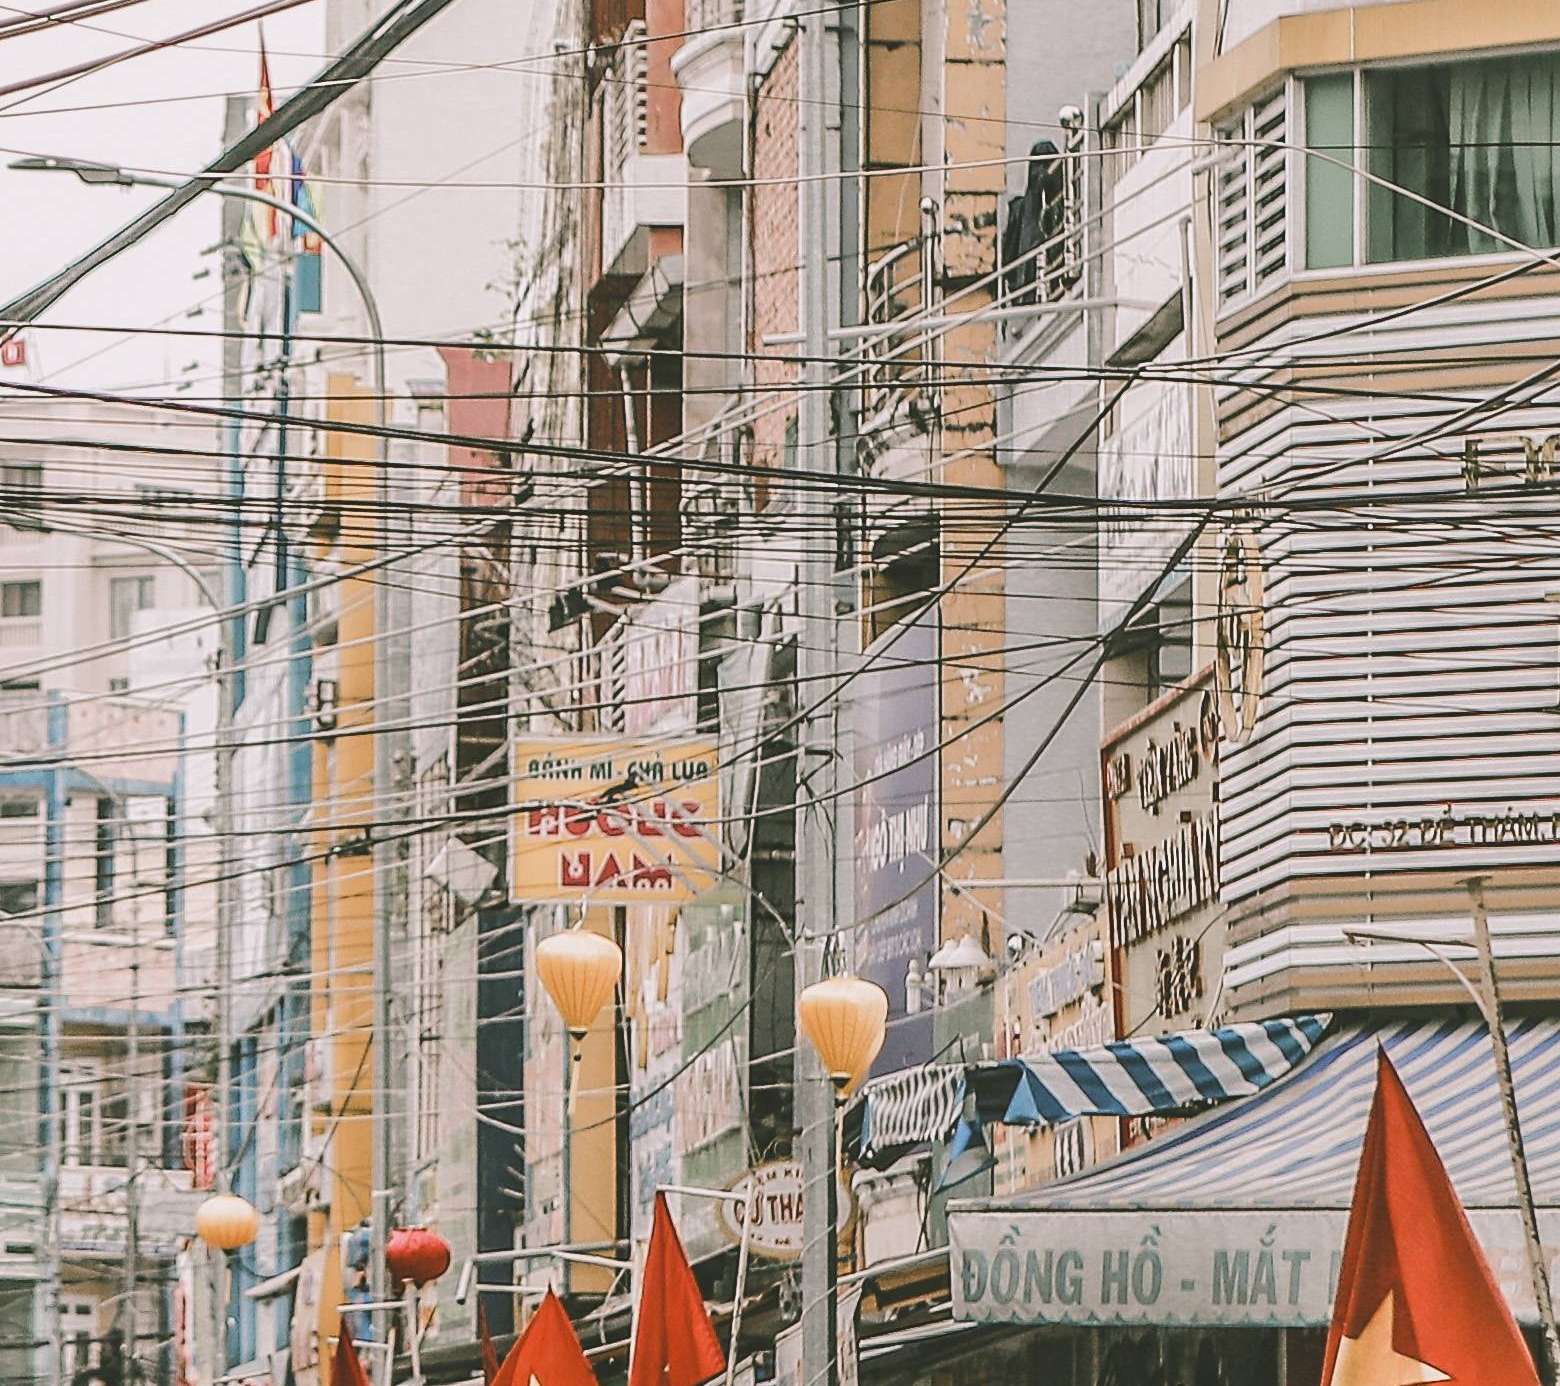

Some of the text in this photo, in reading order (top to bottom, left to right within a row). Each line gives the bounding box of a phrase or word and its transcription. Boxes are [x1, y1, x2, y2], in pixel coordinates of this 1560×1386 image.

[561, 852, 673, 890] NAM
[961, 1225, 1084, 1305] ĐỒNG
[1101, 1225, 1163, 1305] HỒ
[1212, 1224, 1311, 1305] MẮT
